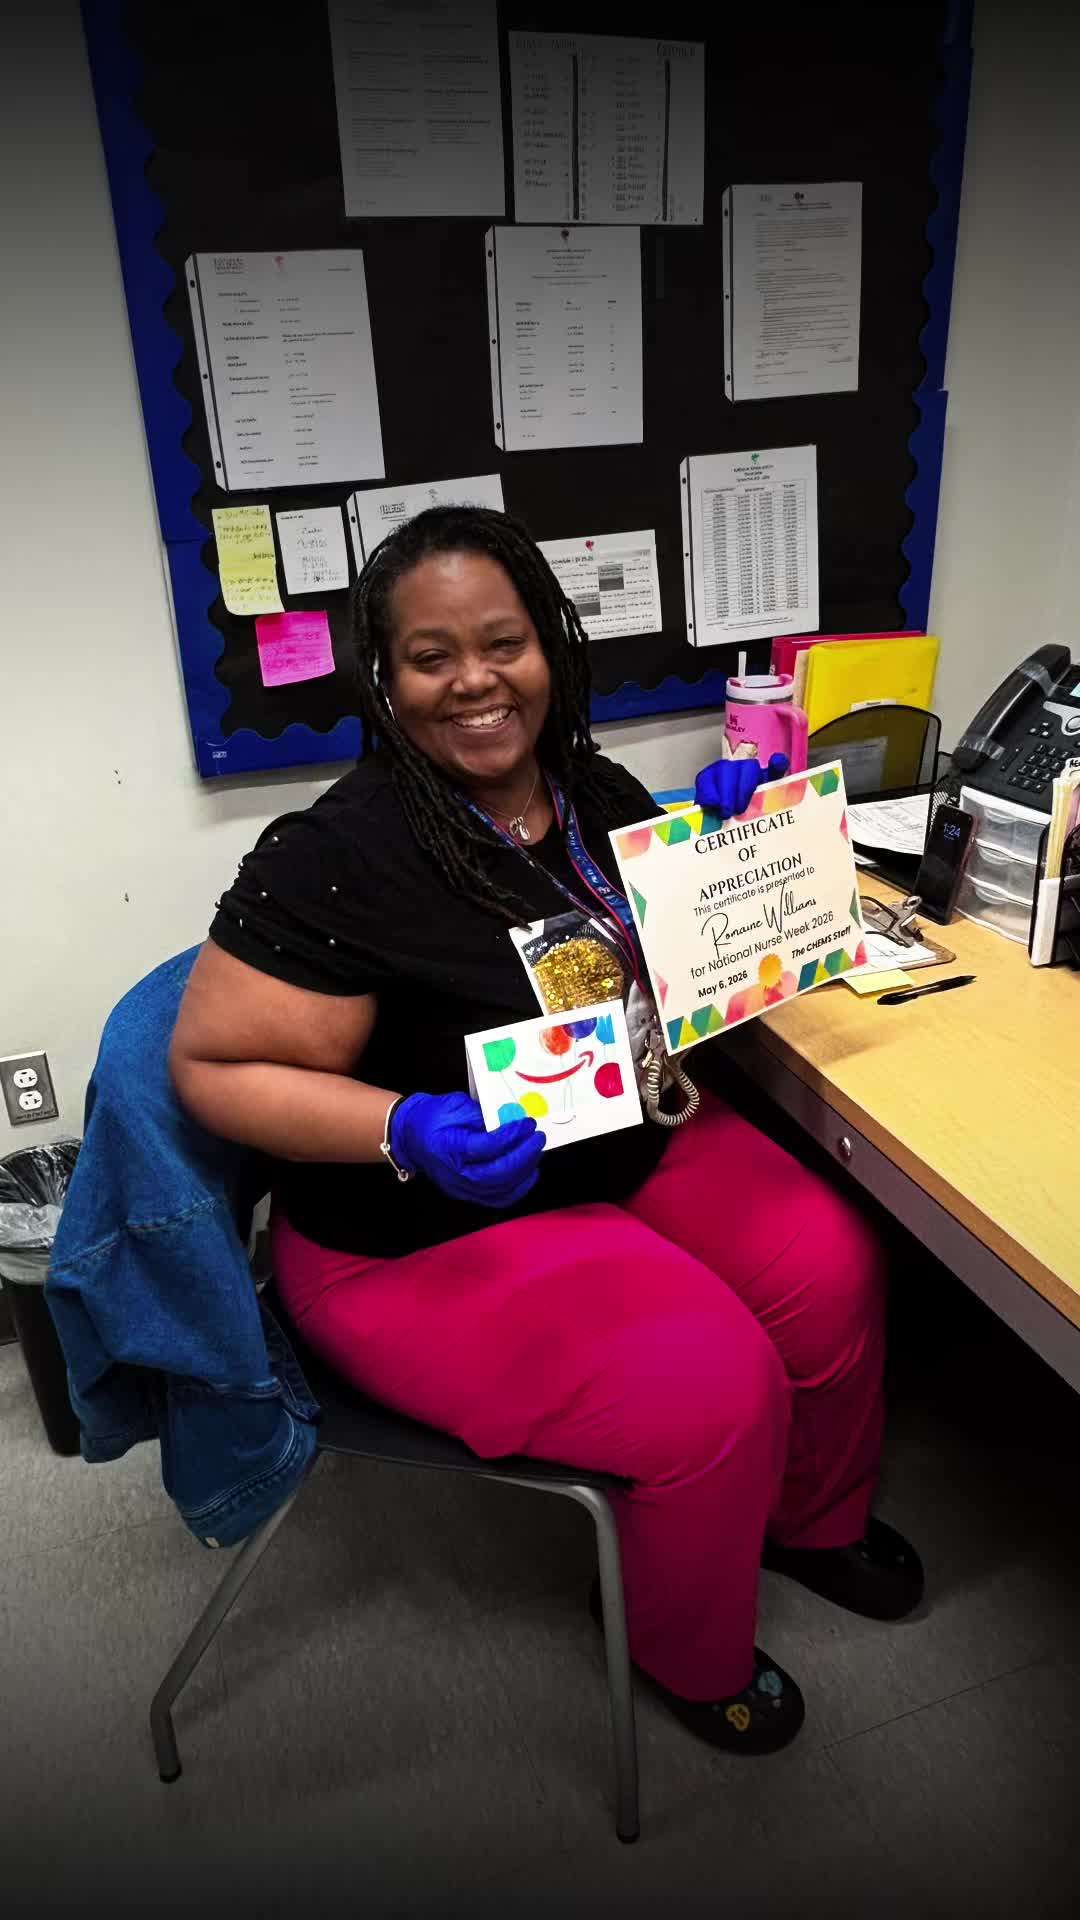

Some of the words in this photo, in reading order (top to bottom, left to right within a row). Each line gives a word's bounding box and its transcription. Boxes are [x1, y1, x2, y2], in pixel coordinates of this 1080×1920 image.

[694, 809, 796, 854] CERTIFICATE
[738, 844, 757, 862] OF
[943, 823, 961, 838] 1:24
[693, 904, 712, 917] This
[712, 888, 757, 910] certificate
[757, 884, 765, 895] is
[765, 867, 806, 895] presented
[806, 866, 816, 875] to
[699, 853, 803, 903] APPRECIATION
[701, 912, 763, 959] Romaine
[762, 882, 817, 934] Williams
[791, 946, 806, 959] The
[806, 935, 832, 952] CHEMS
[833, 925, 852, 941] Staff
[690, 967, 706, 980] for
[708, 944, 753, 973] National
[753, 934, 783, 955] Nurse
[784, 921, 811, 940] Week
[811, 910, 835, 929] 2026
[697, 984, 718, 999] May
[718, 980, 728, 991] 6,
[727, 970, 749, 987] 2026
